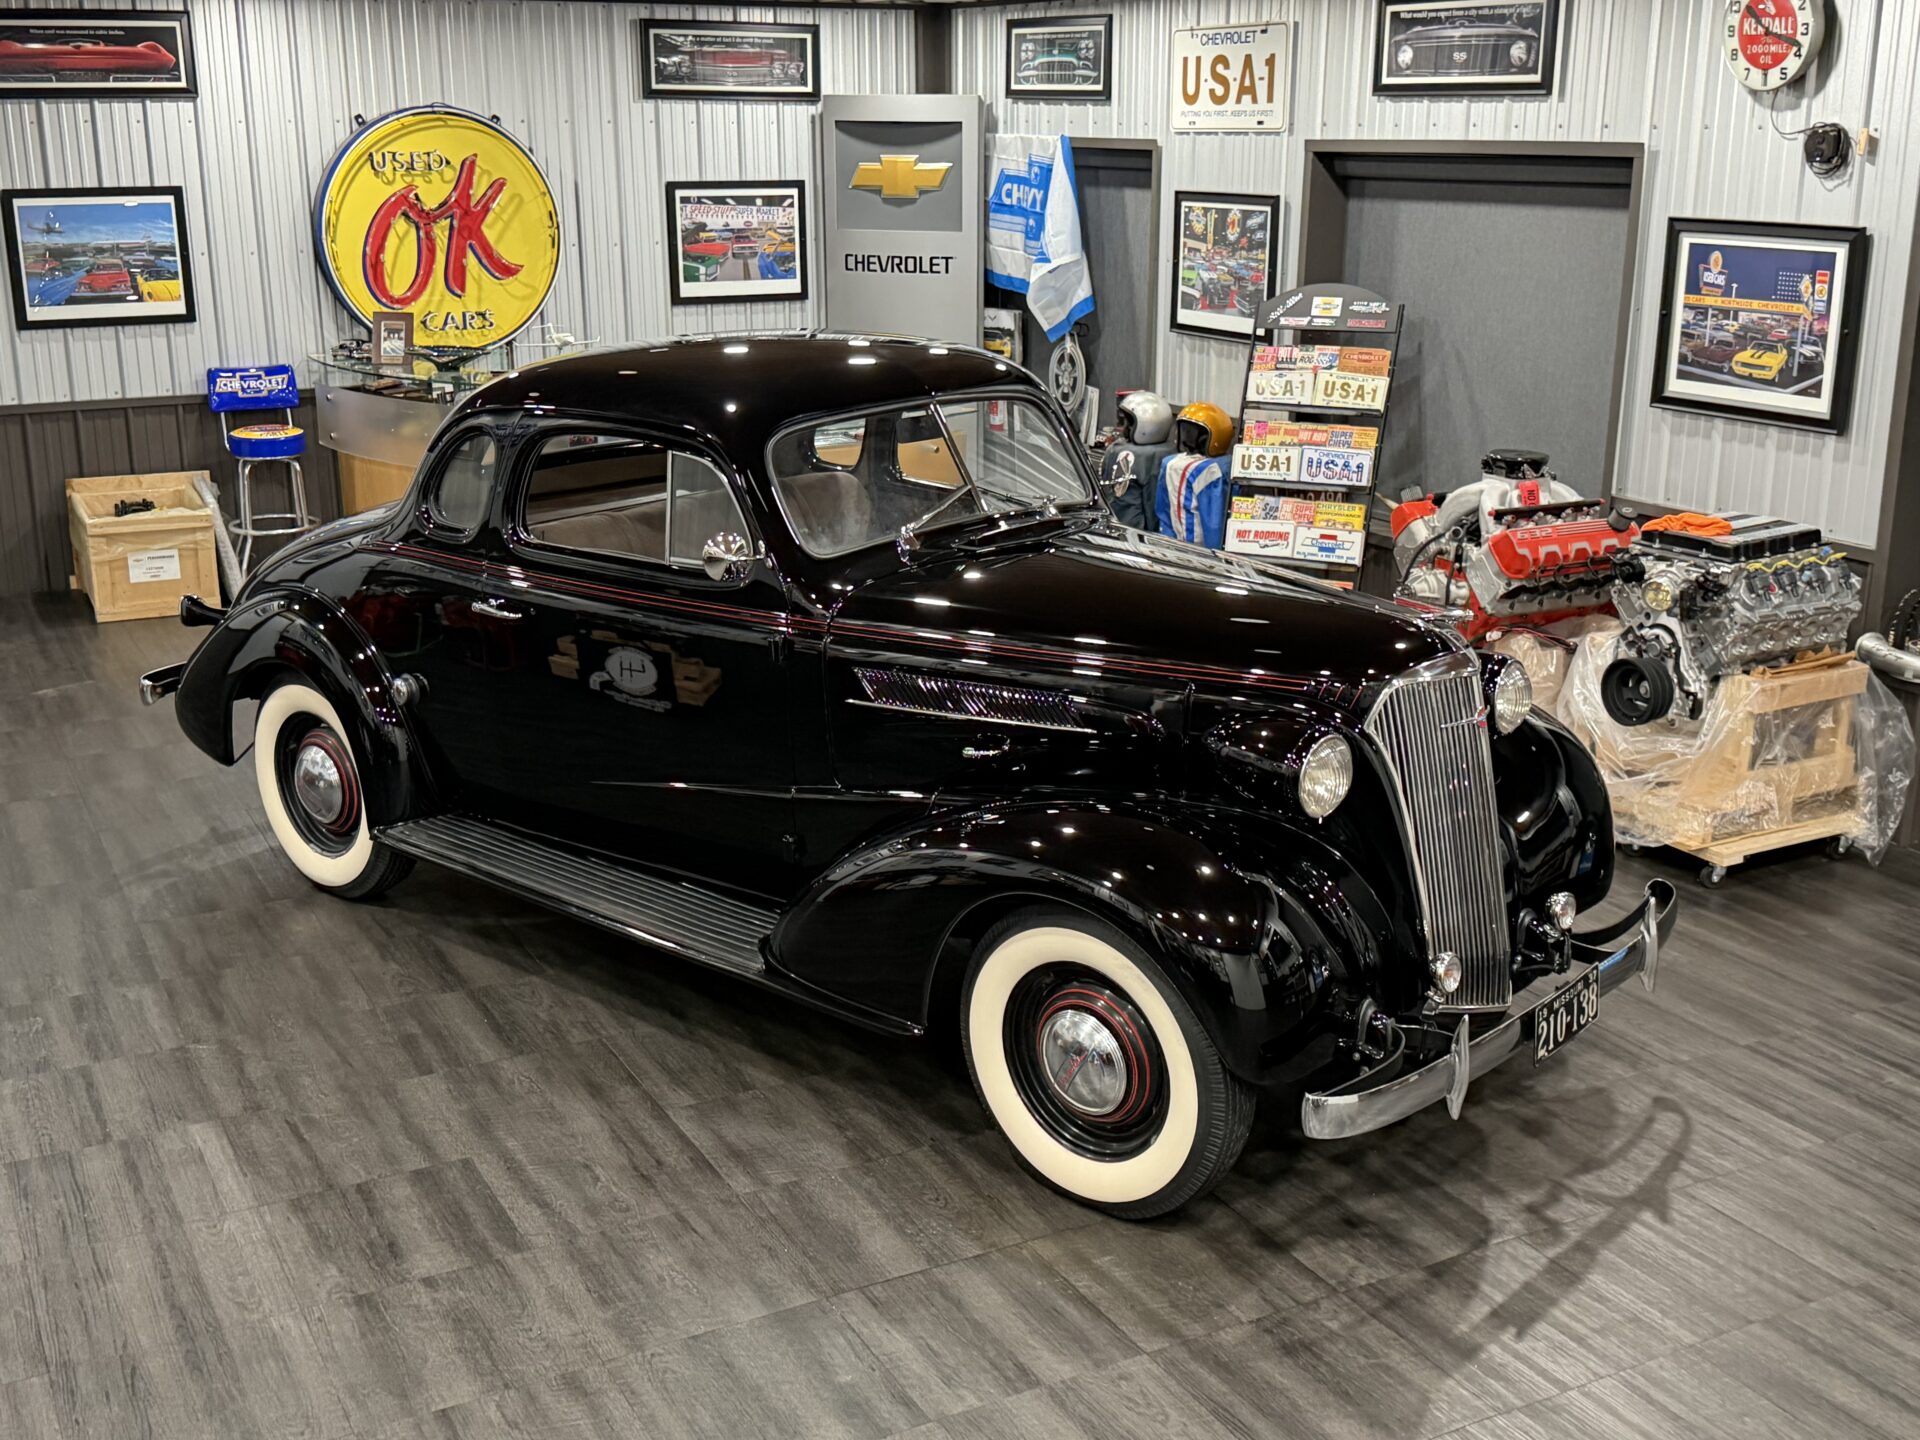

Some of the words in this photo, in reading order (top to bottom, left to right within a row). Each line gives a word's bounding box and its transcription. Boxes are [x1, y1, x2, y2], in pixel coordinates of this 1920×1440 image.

[1727, 25, 1735, 38] 9
[1743, 16, 1795, 36] KENDALL
[1800, 22, 1809, 36] 3
[1200, 30, 1258, 46] CHEVROLET
[1452, 51, 1468, 61] SS
[1730, 48, 1739, 61] 8
[1759, 55, 1773, 65] OIL
[1793, 46, 1803, 60] 4
[1743, 67, 1751, 81] 7
[1779, 67, 1788, 81] 5
[369, 150, 450, 172] USED
[362, 153, 525, 310] OK
[844, 253, 954, 274] CHEVROLET
[1757, 302, 1795, 311] CHEVROLET
[420, 309, 496, 332] CARS
[220, 377, 283, 391] CHEVROLET
[1300, 430, 1313, 442] HOT
[1313, 431, 1327, 443] ROD
[1329, 430, 1353, 441] SUPER
[1327, 438, 1351, 449] CHEVY
[1318, 451, 1354, 461] CHEVROLET
[1316, 502, 1357, 512] CHRYSLER
[1236, 529, 1251, 540] HOT
[1253, 530, 1291, 541] RODDING
[1517, 527, 1553, 541] 632
[1310, 538, 1345, 550] Chevrolet
[1538, 1007, 1549, 1022] 19
[1553, 980, 1585, 1012] MISSOURI
[1588, 969, 1598, 983] 37
[1537, 981, 1598, 1060] 210-138
